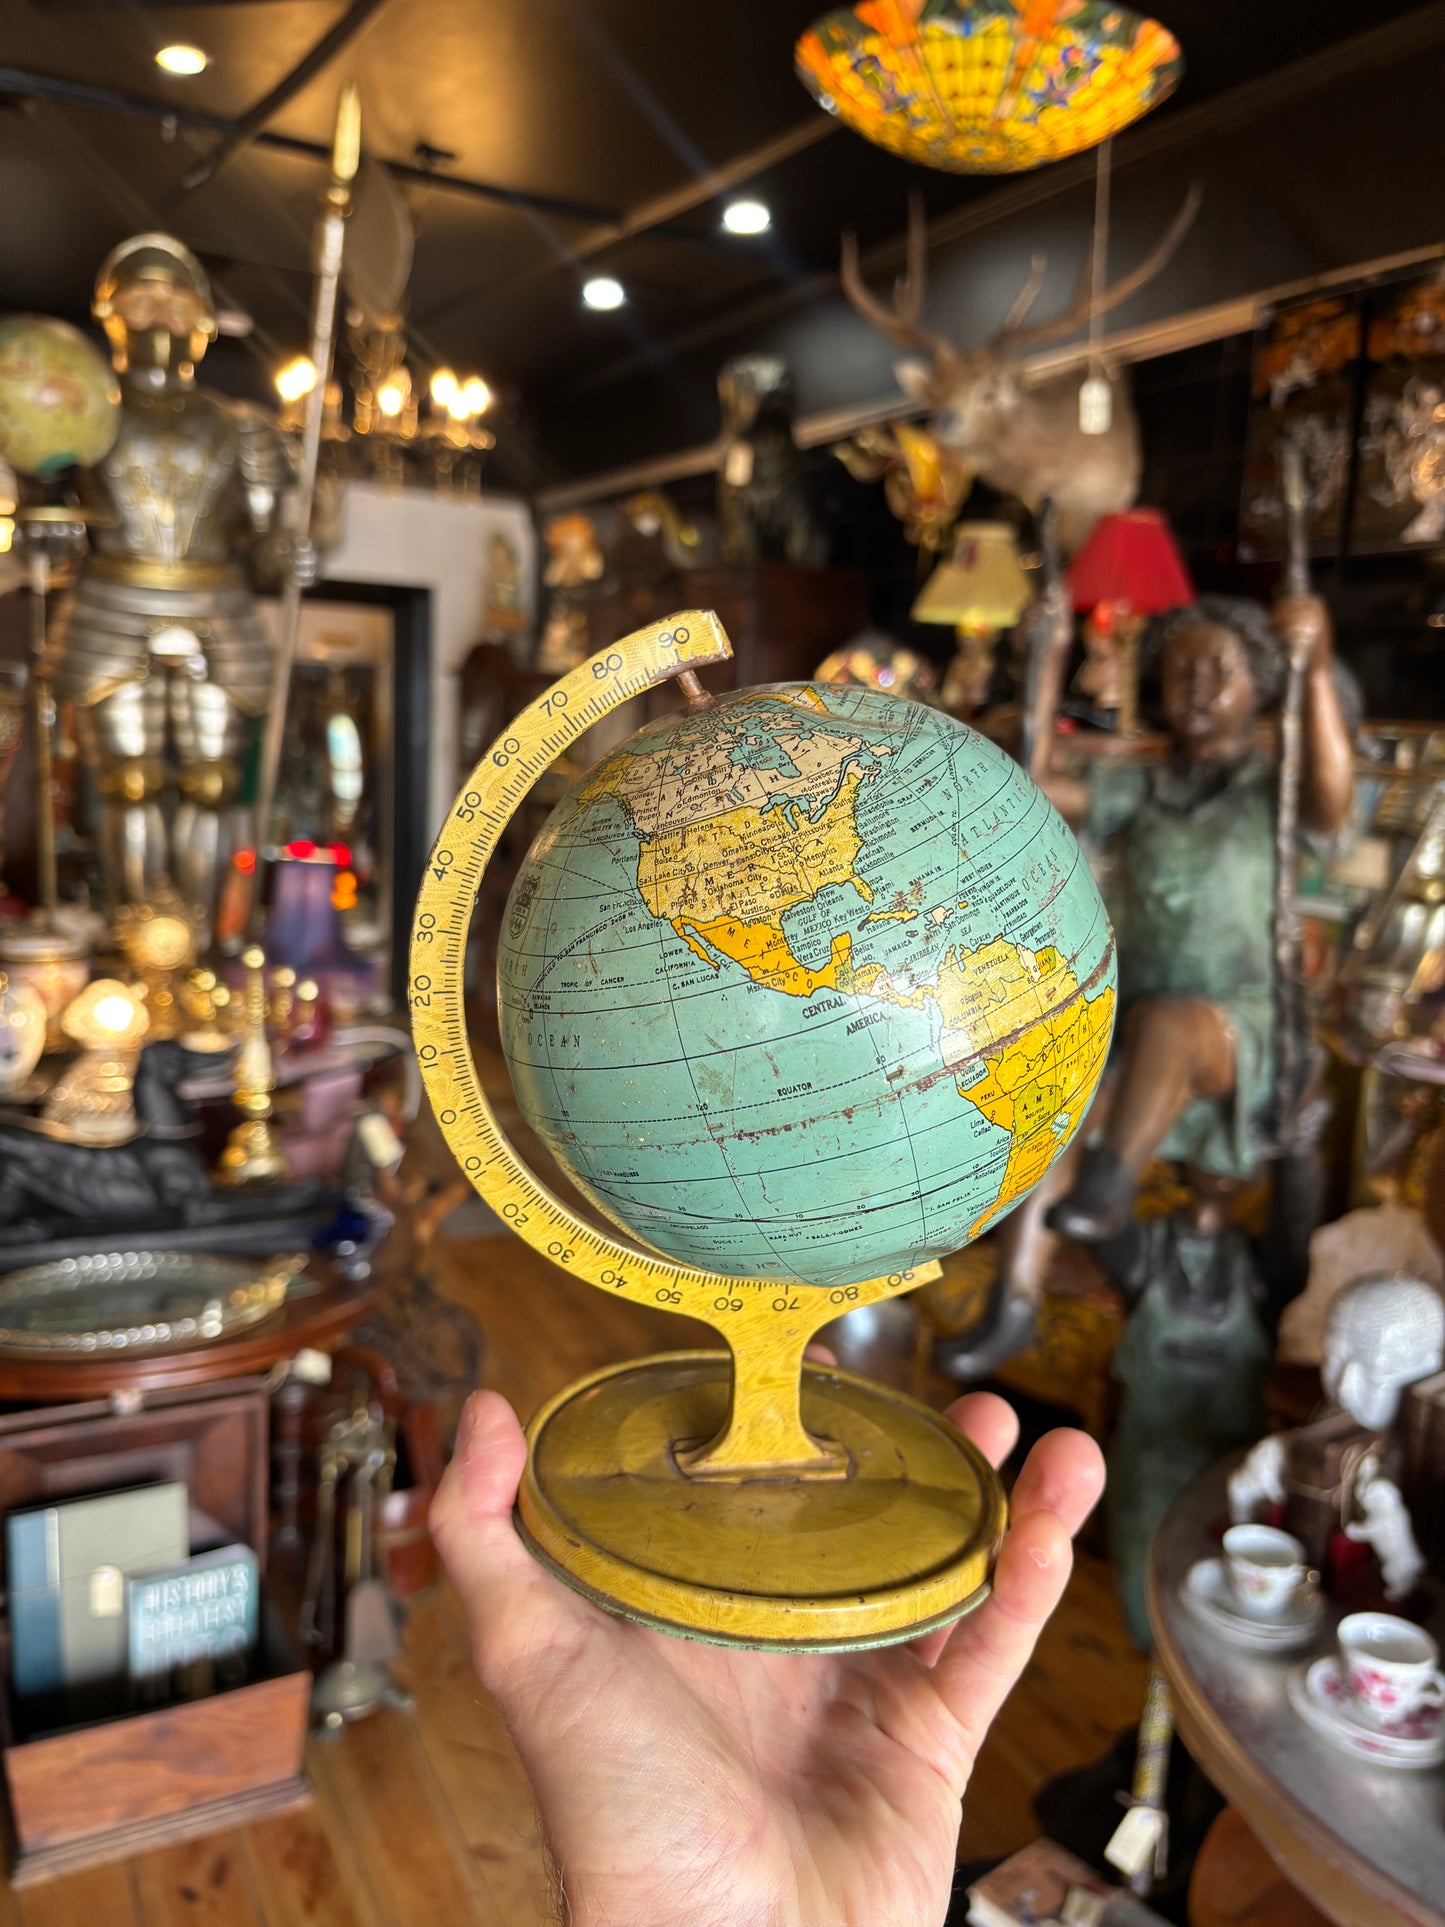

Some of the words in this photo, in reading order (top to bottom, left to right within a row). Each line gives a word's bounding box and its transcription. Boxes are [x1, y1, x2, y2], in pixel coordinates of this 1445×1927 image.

[657, 626, 691, 648] 90
[591, 653, 623, 680] 80
[538, 690, 568, 718] 70
[492, 737, 521, 768] 60
[695, 766, 727, 783] Churchill
[807, 770, 834, 784] Quebec
[800, 778, 832, 794] Montreal
[682, 788, 720, 805] Edmonton
[870, 790, 884, 802] York
[456, 791, 482, 823] 50
[636, 807, 658, 817] Prince
[855, 799, 894, 820] Philadelphia
[638, 812, 660, 823] Rupert
[651, 816, 688, 831] Vancouver
[858, 810, 890, 830] Baltimore
[910, 815, 937, 833] BERMUDA
[655, 830, 680, 841] Seattle
[687, 821, 714, 835] Helena
[740, 820, 785, 842] Minneapolis
[862, 817, 900, 838] Washington
[760, 831, 791, 846] Chicago
[864, 830, 897, 849] Richmond
[611, 853, 638, 865] Portland
[722, 844, 748, 858] Omaha
[778, 850, 788, 861] St.
[804, 846, 838, 863] Memphis
[432, 850, 454, 881] 40
[703, 859, 729, 870] Denver
[780, 856, 798, 869] Louis
[819, 863, 845, 878] Atlanta
[856, 851, 894, 875] Jacksonville
[655, 870, 671, 881] Lake
[672, 866, 687, 877] City
[960, 872, 975, 885] WEST
[976, 862, 993, 876] INDIES
[707, 879, 744, 896] Oklahoma
[747, 873, 762, 883] City
[874, 882, 895, 896] Miami
[670, 896, 698, 910] Phoenix
[817, 894, 844, 910] Orleans
[820, 889, 836, 901] New
[993, 889, 1021, 913] MARTINIQUE
[599, 902, 612, 913] San
[730, 902, 738, 912] El
[738, 897, 757, 908] Paso
[740, 904, 764, 916] Austin
[797, 913, 816, 926] GULF
[820, 909, 831, 919] OF
[834, 912, 848, 923] Key
[847, 905, 865, 917] West
[417, 913, 436, 943] 30
[625, 924, 636, 935] Los
[637, 920, 664, 932] Angeles
[803, 920, 832, 936] MEXICO
[866, 920, 892, 935] Havana
[960, 924, 972, 937] SEA
[575, 924, 608, 948] FRANCISCO
[659, 948, 684, 960] LOWER
[791, 939, 822, 954] Tampico
[853, 942, 875, 957] Belize
[883, 939, 913, 957] JAMAICA
[904, 942, 940, 966] CARIBBEAN
[727, 926, 813, 989] MEXICO
[796, 950, 814, 964] Vera
[814, 946, 830, 957] Cruz
[654, 960, 696, 975] CALIFORNIA
[973, 953, 1010, 976] VENEZUELA
[561, 981, 579, 989] TROPIC
[584, 980, 593, 988] OF
[600, 976, 625, 986] CANCER
[672, 983, 680, 991] C.
[680, 979, 694, 989] SAN
[696, 973, 720, 984] LUCAS
[746, 982, 771, 995] Mexico
[771, 978, 786, 988] City
[414, 974, 432, 1007] 20
[802, 998, 847, 1020] CENTRAL
[950, 1004, 982, 1027] COLUMBIA
[846, 1011, 887, 1036] AMERICA
[528, 1032, 581, 1048] OCEAN
[1026, 1023, 1087, 1073] SOUTH
[420, 1044, 438, 1069] 10
[876, 1055, 887, 1065] 90
[960, 1066, 976, 1077] Quito
[961, 1068, 988, 1089] ECUADOR
[776, 1082, 813, 1096] EQUATOR
[980, 1090, 995, 1102] PERU
[696, 1103, 709, 1112] 120
[440, 1109, 457, 1125] 0
[970, 1118, 986, 1129] Lima
[974, 1125, 992, 1138] Callao
[996, 1134, 1010, 1147] Arica
[465, 1155, 486, 1179] 10
[937, 1201, 950, 1209] SAN
[502, 1203, 529, 1229] 20
[547, 1241, 576, 1265] 30
[600, 1270, 629, 1290] 40
[887, 1269, 915, 1287] 90
[656, 1288, 684, 1304] 50
[830, 1286, 859, 1304] 80
[714, 1296, 744, 1312] 60
[772, 1298, 801, 1312] 70
